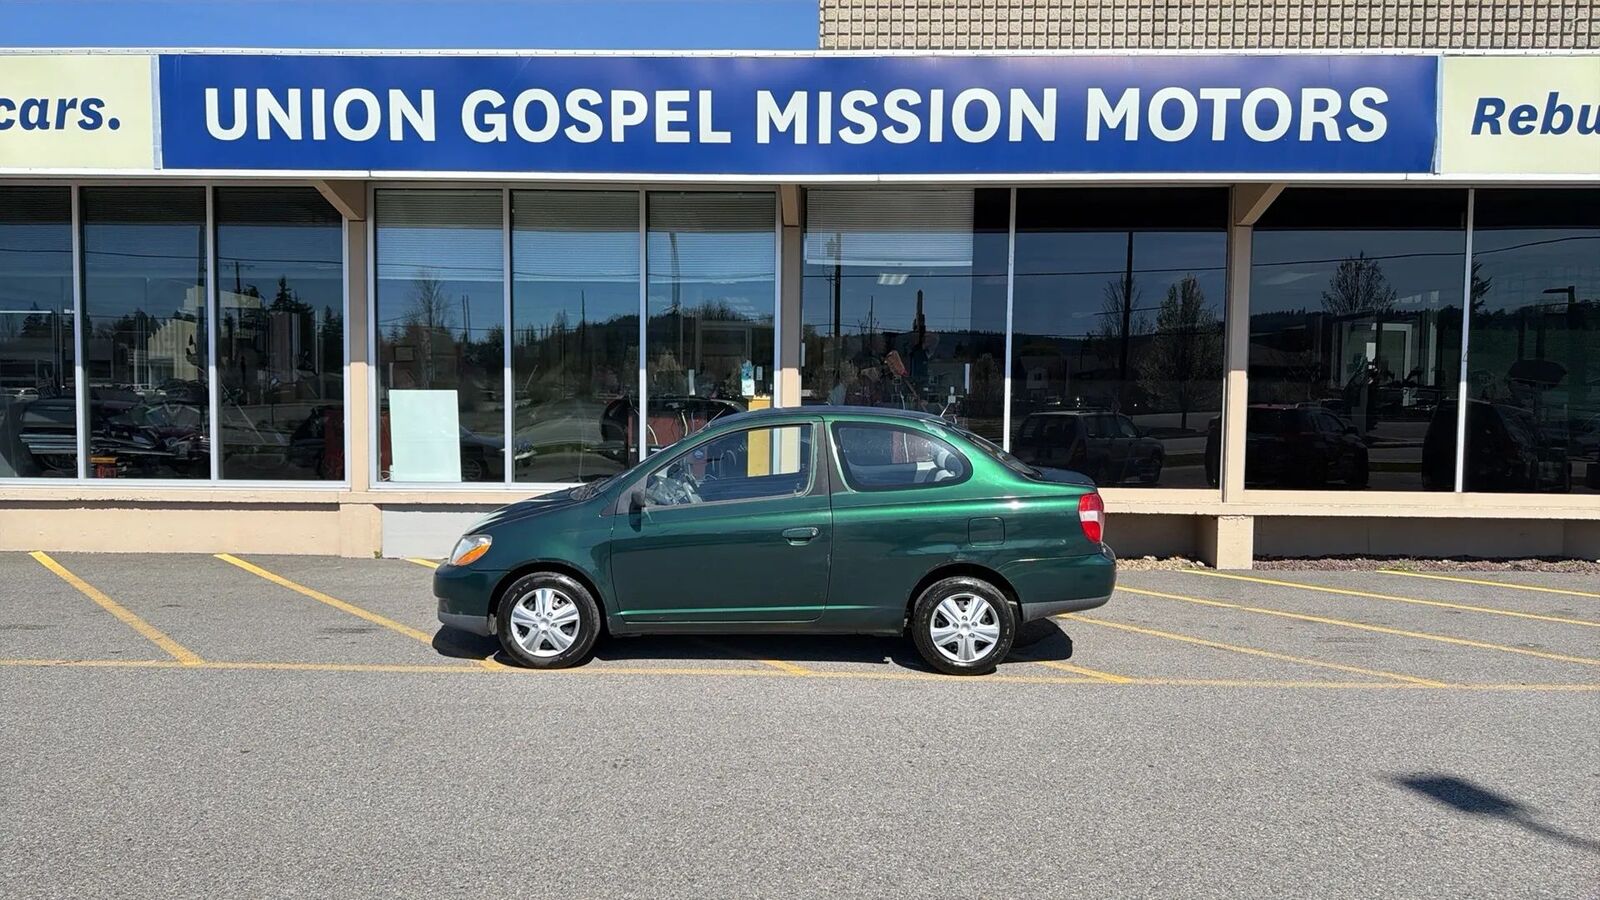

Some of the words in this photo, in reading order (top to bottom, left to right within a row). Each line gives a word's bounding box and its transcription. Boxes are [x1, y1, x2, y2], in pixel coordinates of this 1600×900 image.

[204, 87, 437, 142] UNION
[461, 87, 732, 145] GOSPEL
[756, 87, 1058, 146] MISSION
[1085, 85, 1389, 143] MOTORS
